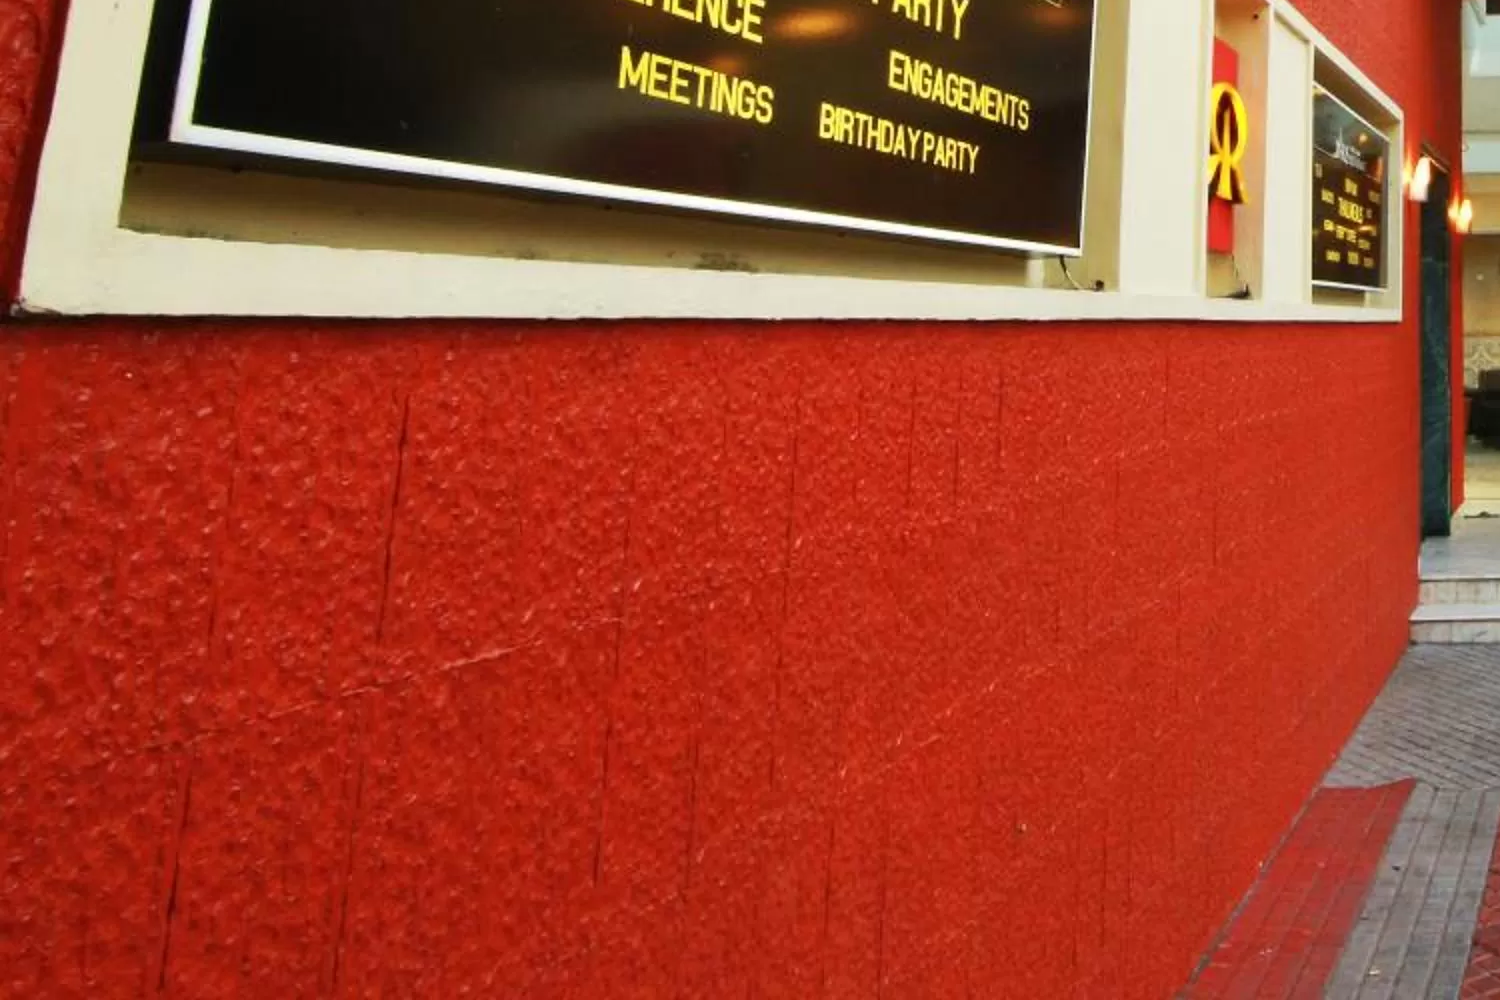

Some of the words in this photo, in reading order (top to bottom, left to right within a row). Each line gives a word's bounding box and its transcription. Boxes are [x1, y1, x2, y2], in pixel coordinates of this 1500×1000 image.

[618, 45, 775, 124] MEETINGS
[887, 49, 1030, 131] ENGAGEMENTS
[819, 102, 921, 161] BIRTHDAY
[921, 130, 980, 174] PARTY
